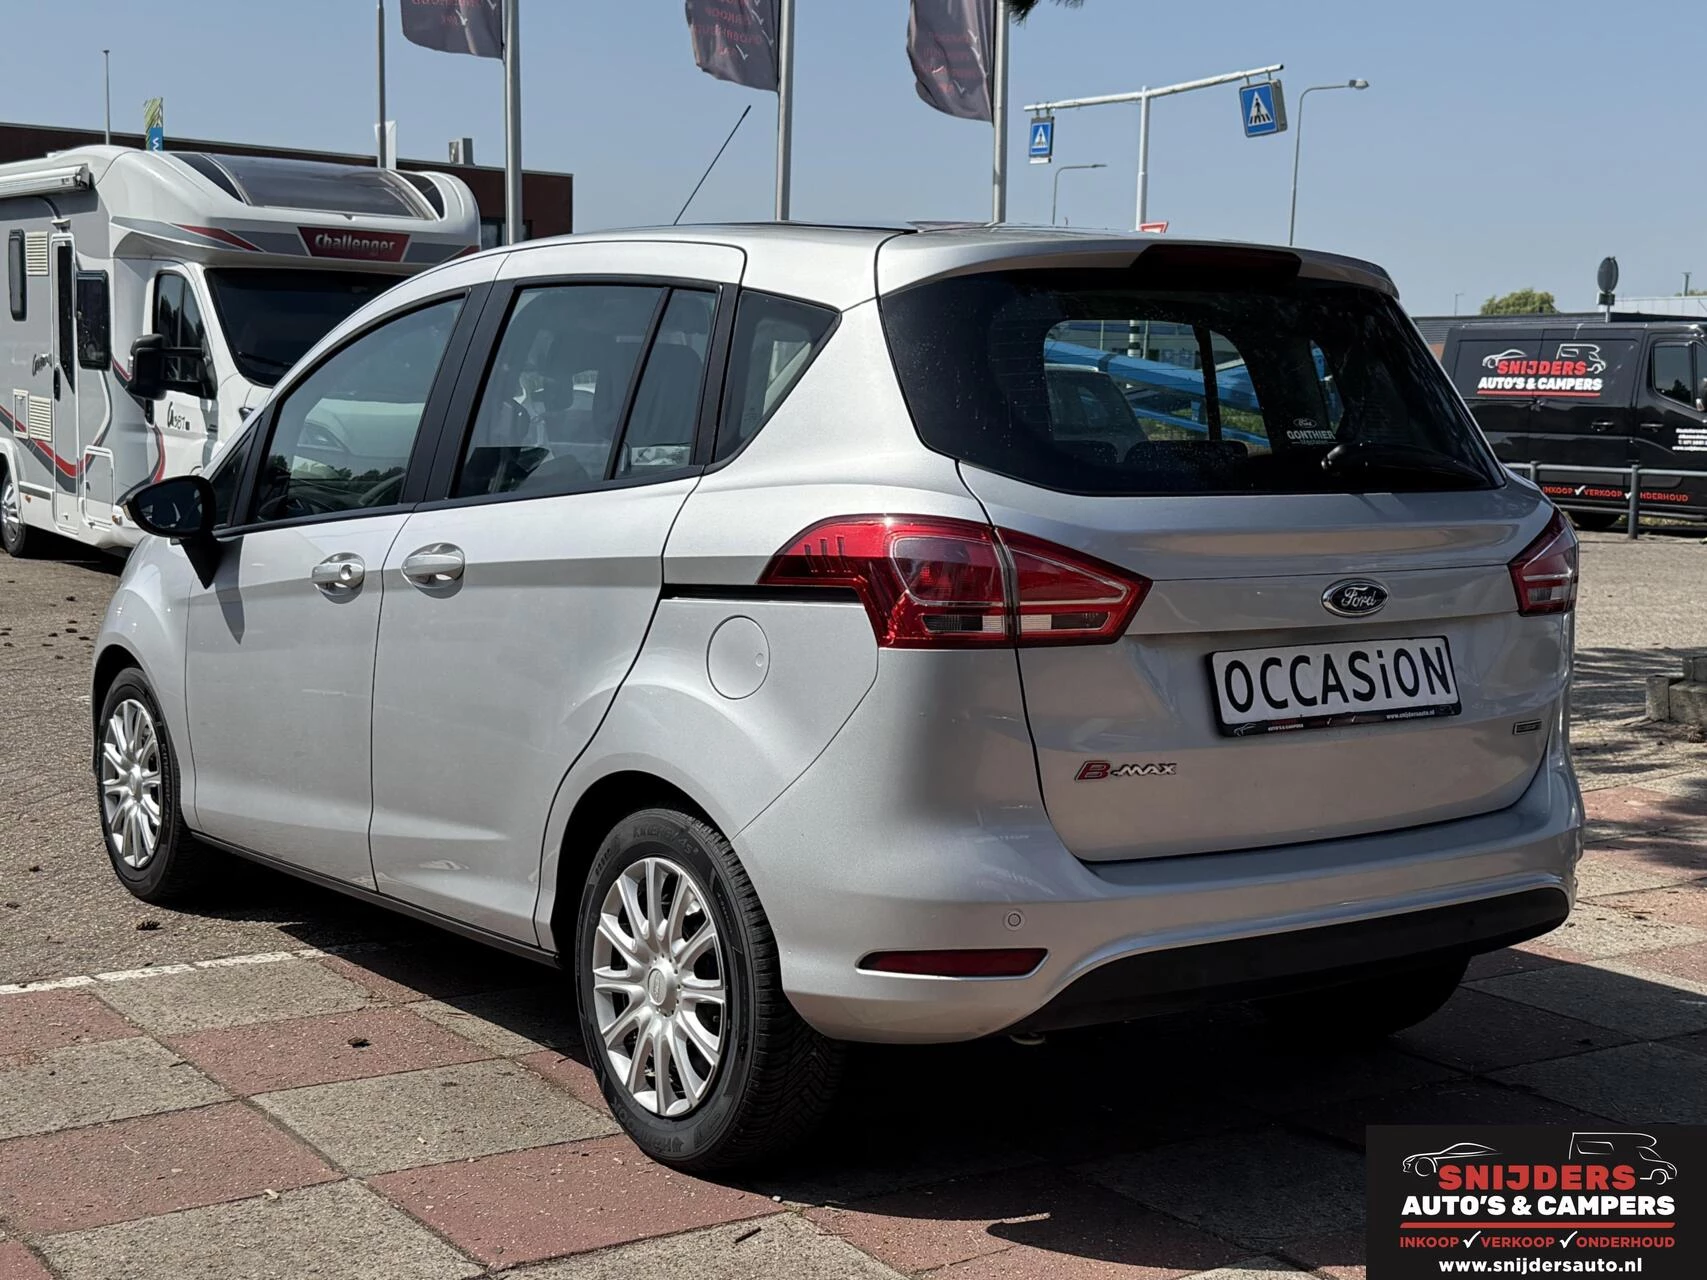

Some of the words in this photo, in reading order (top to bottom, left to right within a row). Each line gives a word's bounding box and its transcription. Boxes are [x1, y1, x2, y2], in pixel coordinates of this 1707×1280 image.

[315, 233, 395, 254] Challenger
[1496, 360, 1588, 376] SNIJDERS
[1477, 377, 1523, 390] AUTO'S
[1523, 378, 1536, 390] &
[1537, 378, 1603, 391] CAMPERS
[1584, 489, 1622, 498] VERKOOP
[1639, 491, 1689, 502] NDERHOUD
[1341, 586, 1377, 607] Ford
[1074, 760, 1177, 781] B-MAX
